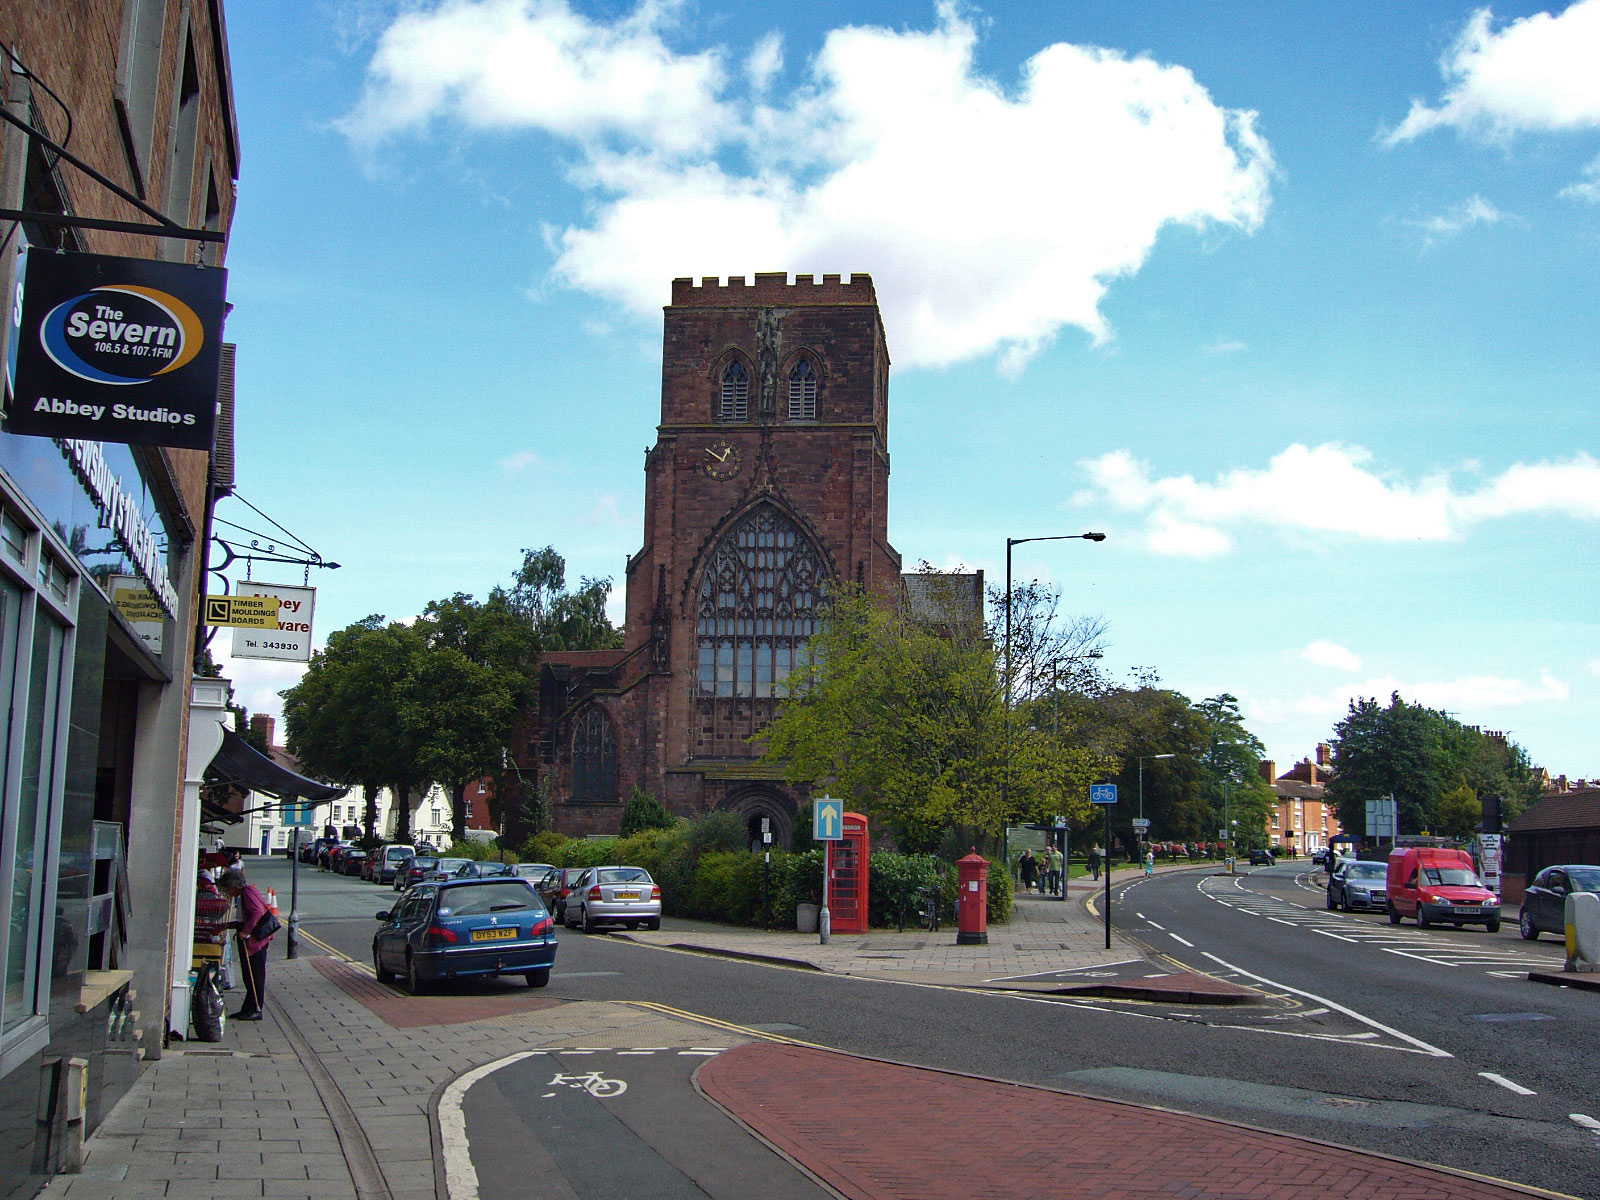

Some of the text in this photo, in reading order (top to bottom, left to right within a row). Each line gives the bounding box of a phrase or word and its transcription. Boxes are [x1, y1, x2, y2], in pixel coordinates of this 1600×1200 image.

[95, 305, 124, 321] The
[67, 311, 177, 347] Severn
[94, 341, 173, 359] 106.5 & 107.1FM
[33, 397, 196, 425] Abbey Studios
[232, 600, 264, 608] TIMBER
[231, 608, 276, 617] MOULDINGS
[231, 617, 265, 625] BOARDS
[245, 640, 299, 651] Tel. 343930
